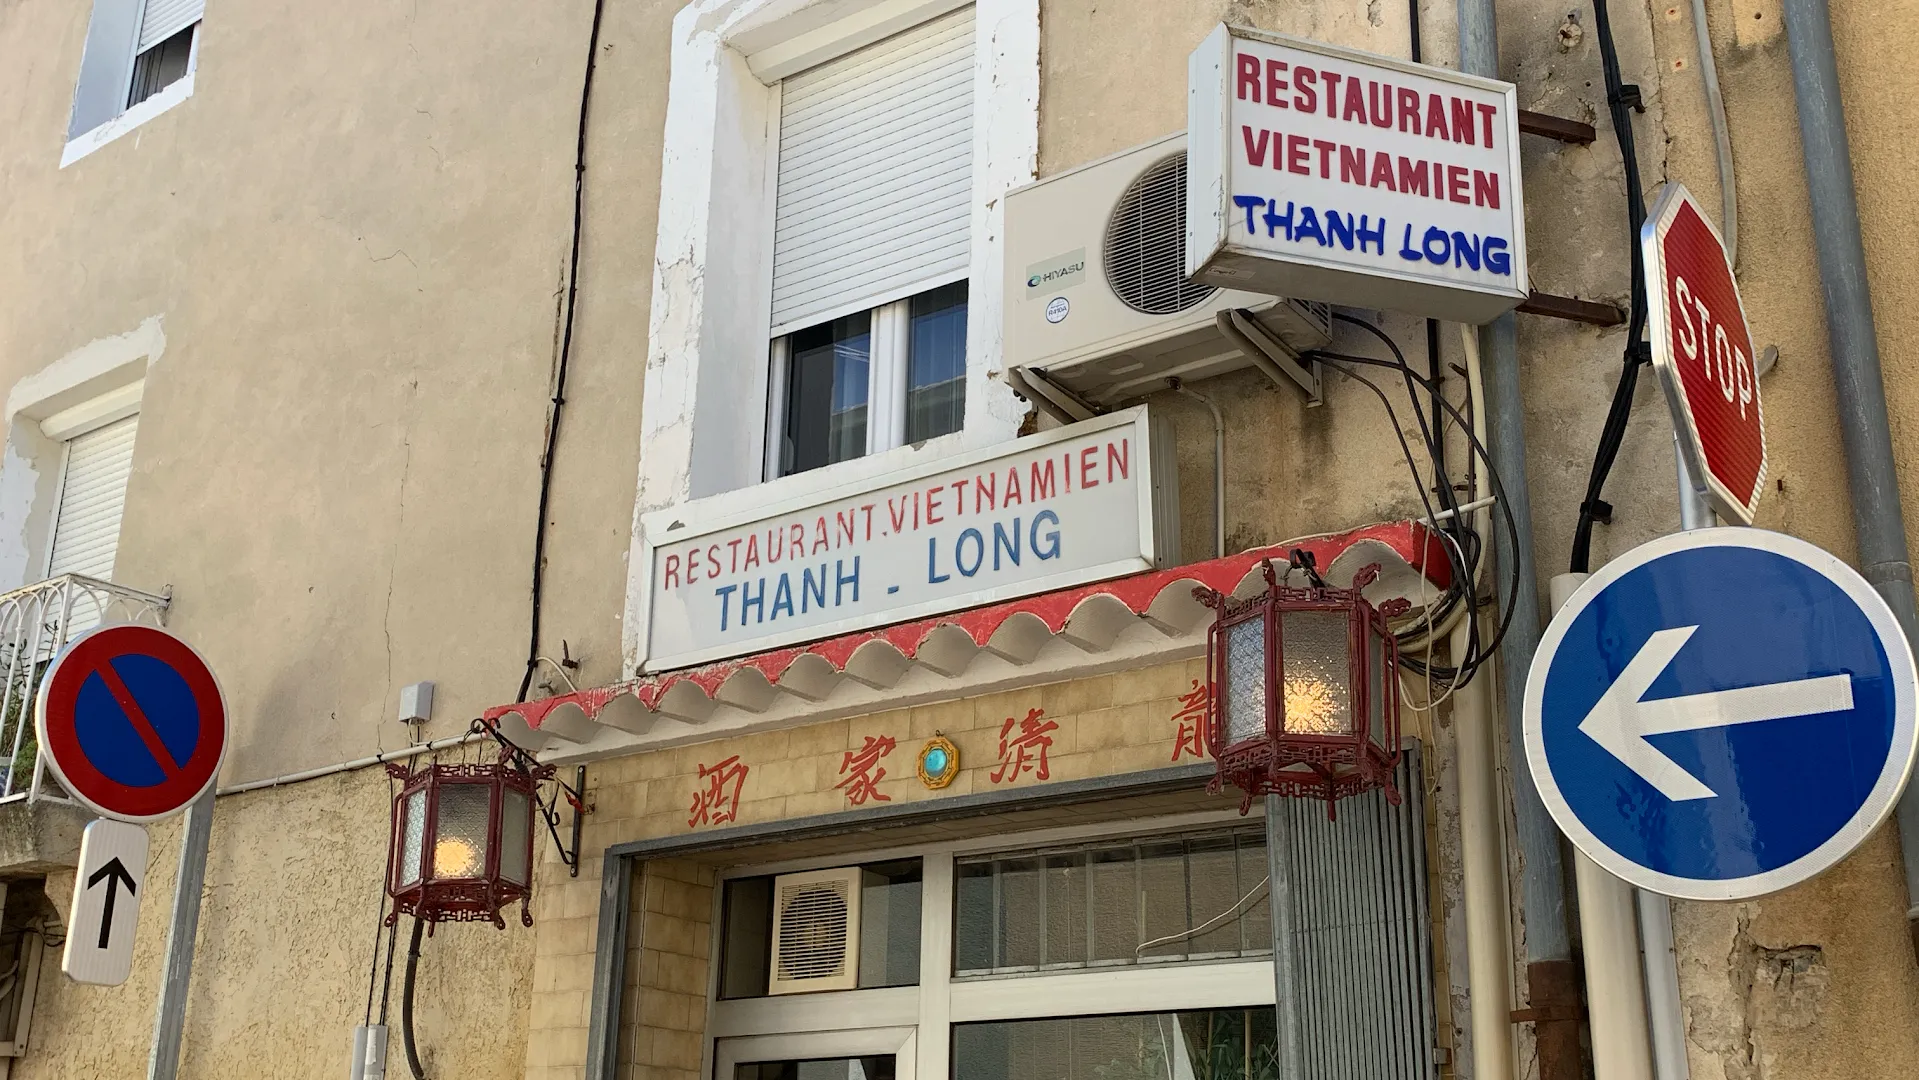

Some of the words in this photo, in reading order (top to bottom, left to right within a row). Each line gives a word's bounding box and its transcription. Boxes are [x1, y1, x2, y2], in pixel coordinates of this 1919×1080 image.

[1236, 52, 1497, 150] RESTAURANT
[1242, 125, 1501, 210] VIETNAMIEN
[1042, 261, 1085, 283] HIYASU
[1233, 194, 1387, 256] THANH
[1399, 223, 1512, 277] LONG
[1675, 275, 1752, 422] STOP
[715, 555, 861, 632] THANH
[928, 509, 1061, 585] LONG
